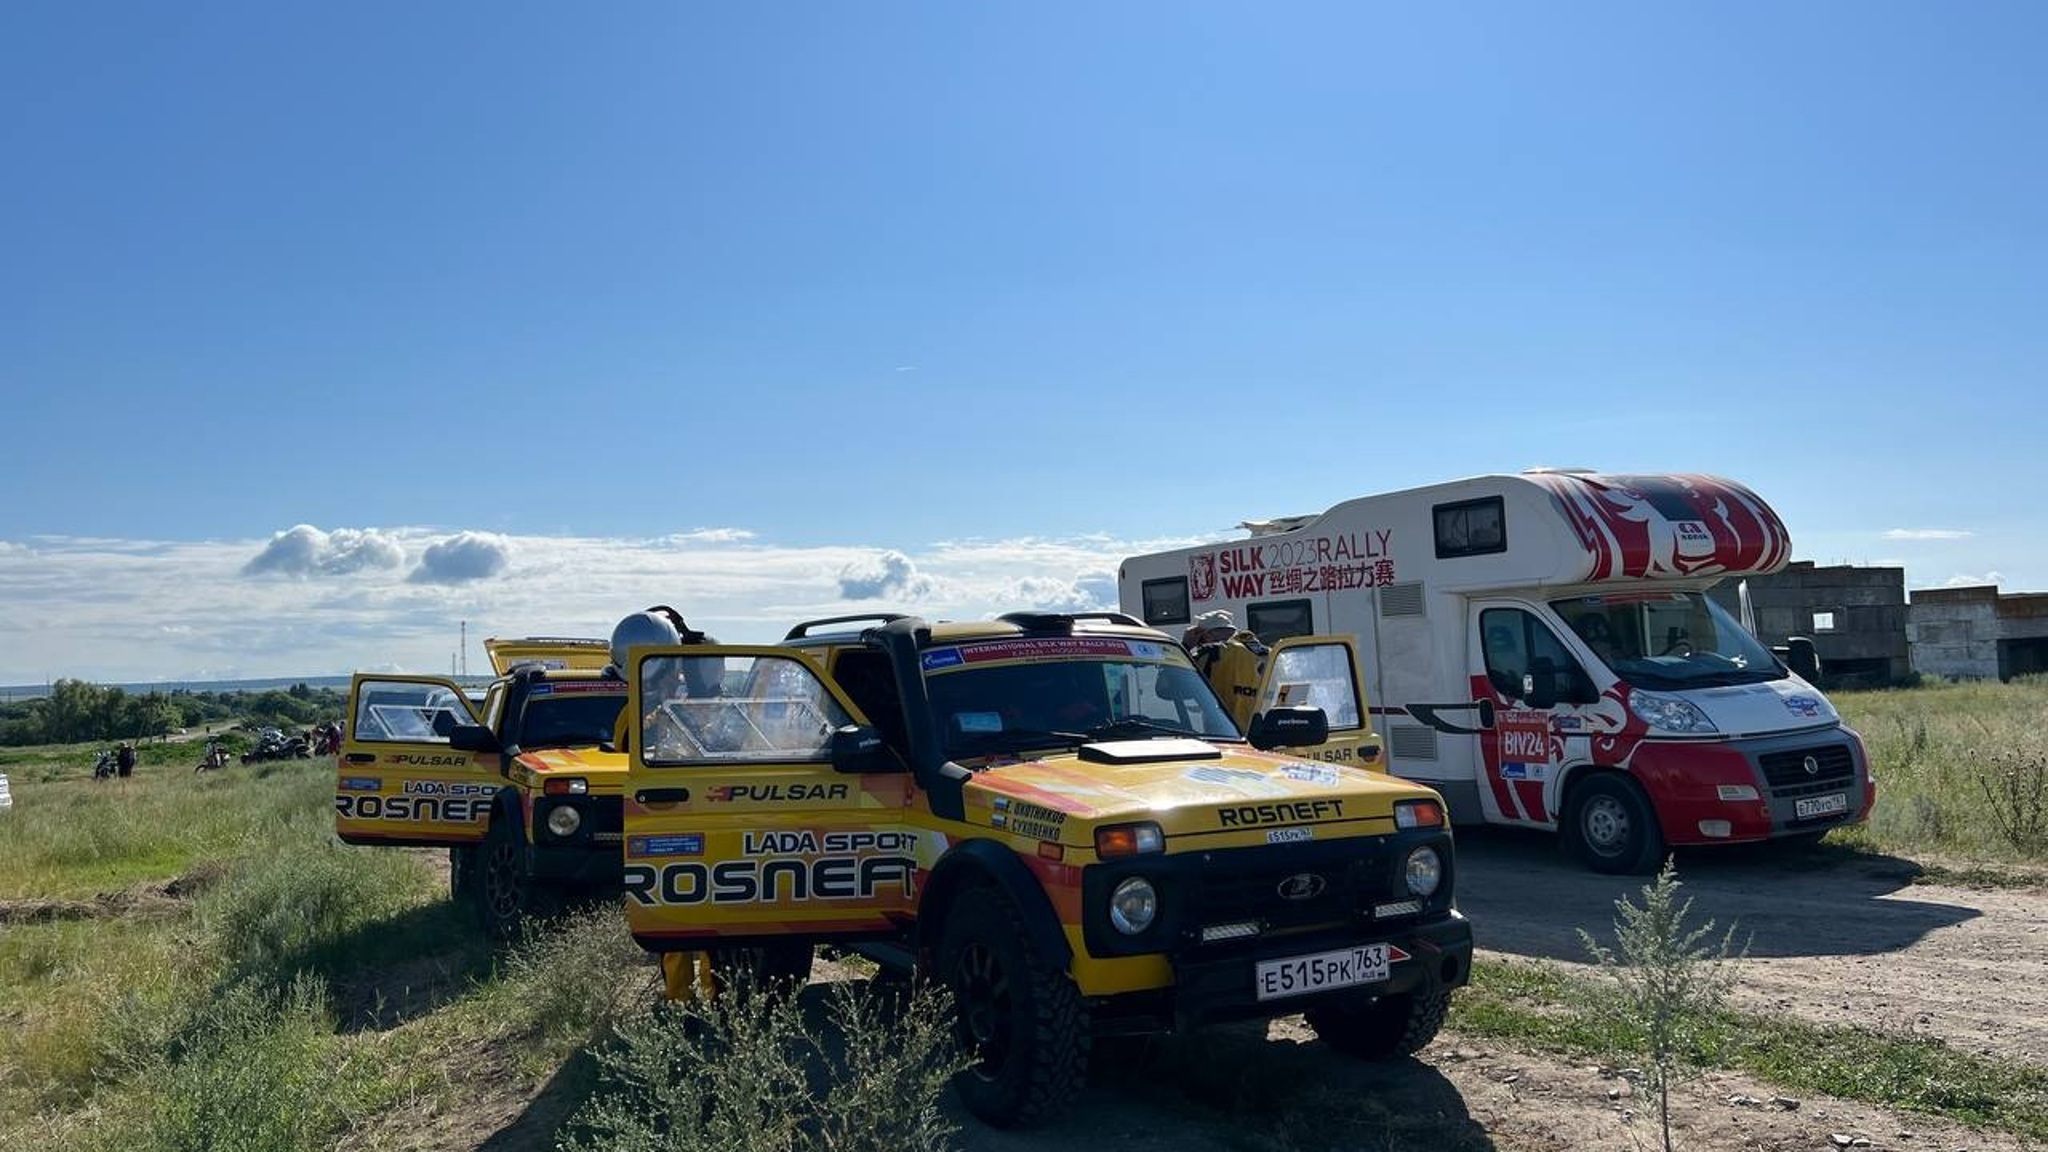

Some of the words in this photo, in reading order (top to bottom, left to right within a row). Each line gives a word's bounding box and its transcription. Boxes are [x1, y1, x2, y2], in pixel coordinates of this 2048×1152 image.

[1219, 546, 1266, 574] SILK
[1270, 540, 1318, 569] 2023
[1318, 529, 1392, 563] RALLY
[1222, 573, 1266, 599] WAY
[1270, 559, 1395, 596] 丝绸之路拉力赛
[1505, 731, 1545, 756] BIV24
[396, 754, 466, 767] PULSAR
[404, 780, 447, 795] LADA
[449, 783, 500, 797] SPO
[729, 784, 849, 801] PULSAR
[336, 796, 494, 821] ROSNEF
[1217, 799, 1343, 827] ROSNEFT
[743, 831, 819, 856] LADA
[824, 832, 918, 853] SPORT
[624, 857, 918, 907] ROSNEFT
[1354, 947, 1382, 971] 763
